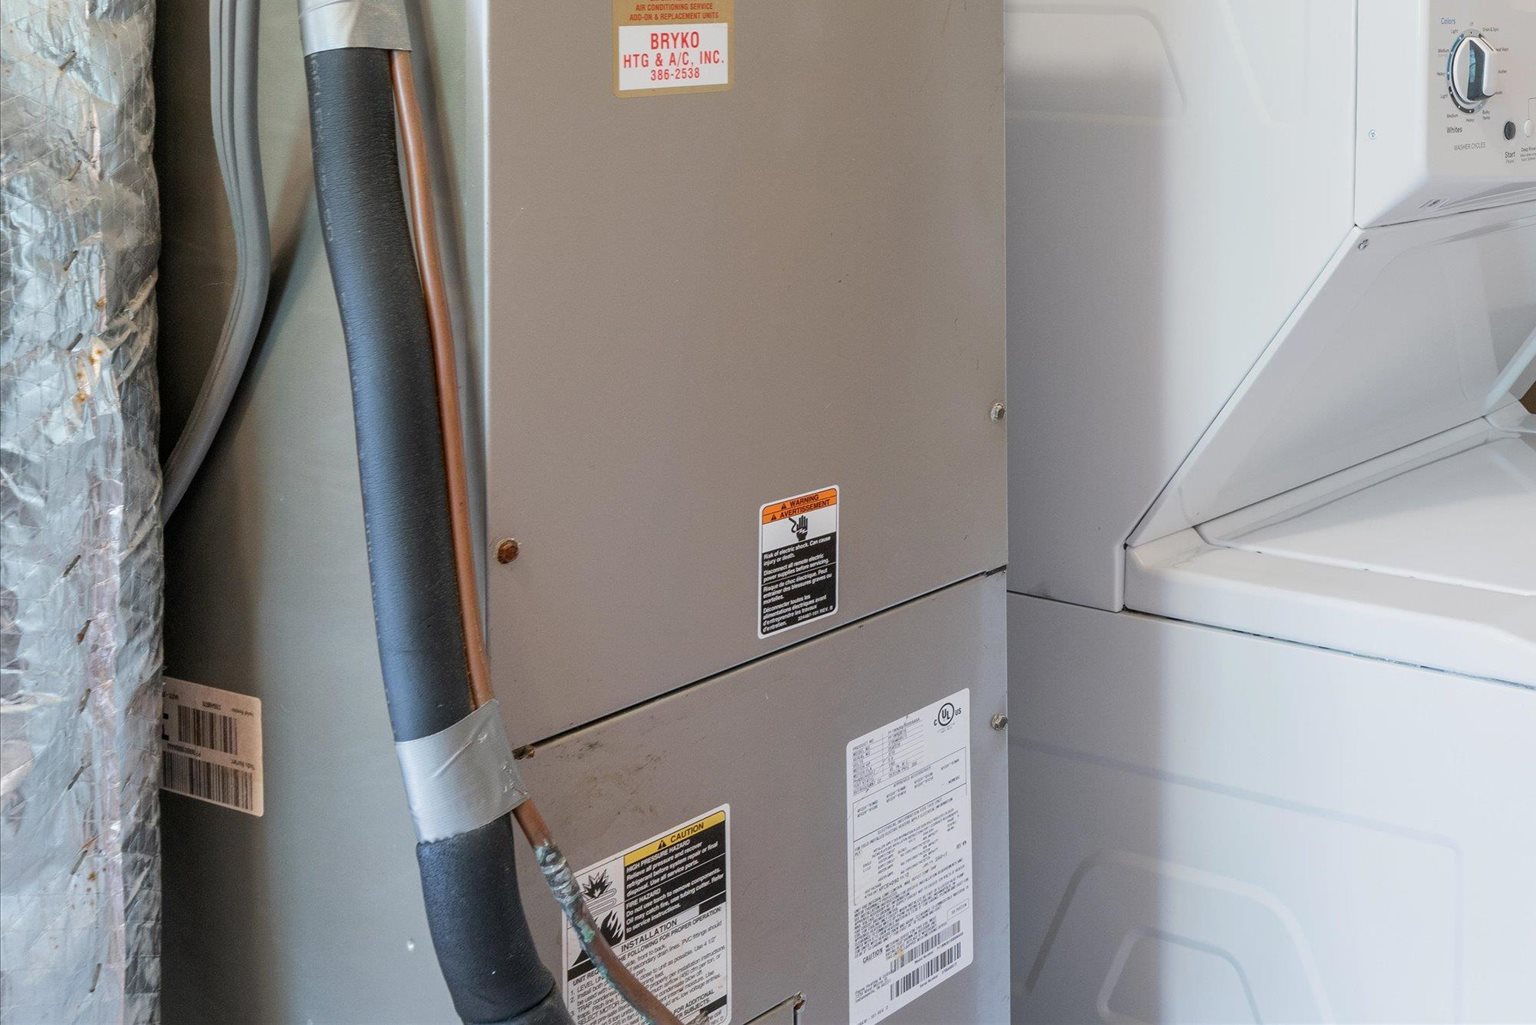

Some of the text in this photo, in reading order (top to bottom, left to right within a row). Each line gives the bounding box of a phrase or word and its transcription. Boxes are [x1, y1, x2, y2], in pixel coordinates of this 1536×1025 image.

[629, 13, 653, 21] ADD-ON
[660, 12, 701, 20] REPLACEMENT
[702, 11, 719, 19] UNITS
[635, 2, 713, 11] AIR CONDITIONING SERVICE
[650, 31, 700, 49] BRYKO
[623, 49, 724, 68] HTG & A/C, INC.
[650, 67, 700, 81] 386-2538
[780, 499, 830, 519] AVERTISSEMENT
[790, 494, 818, 508] WARNING
[763, 552, 772, 560] Risk
[779, 546, 794, 555] electric
[955, 707, 961, 716] US
[670, 822, 703, 843] CAUTION
[626, 839, 690, 874] HIGH PRESSURE HAZARD
[626, 869, 644, 881] Relieve
[652, 855, 673, 870] pressure
[674, 850, 683, 858] and
[684, 841, 702, 854] recover
[626, 873, 652, 890] refrigerant
[653, 865, 668, 876] before
[669, 857, 686, 870] system
[667, 865, 684, 877] service
[626, 888, 660, 909] FIRE HAZARD
[626, 909, 633, 917] Do
[634, 905, 642, 913] not
[643, 900, 652, 908] use
[653, 894, 665, 904] torch
[672, 883, 690, 894] remove
[634, 913, 644, 922] may
[645, 905, 659, 915] catch
[670, 896, 679, 904] use
[632, 918, 650, 930] service
[621, 919, 677, 952] INSTALLATION
[573, 975, 585, 986] UNIT
[627, 937, 658, 958] FOLLOWING
[659, 932, 669, 942] FOR
[671, 921, 691, 936] PROPER
[862, 948, 882, 964] CAUTION
[576, 980, 593, 992] LEVEL
[673, 989, 713, 1015] FOR ADDITIONAL
